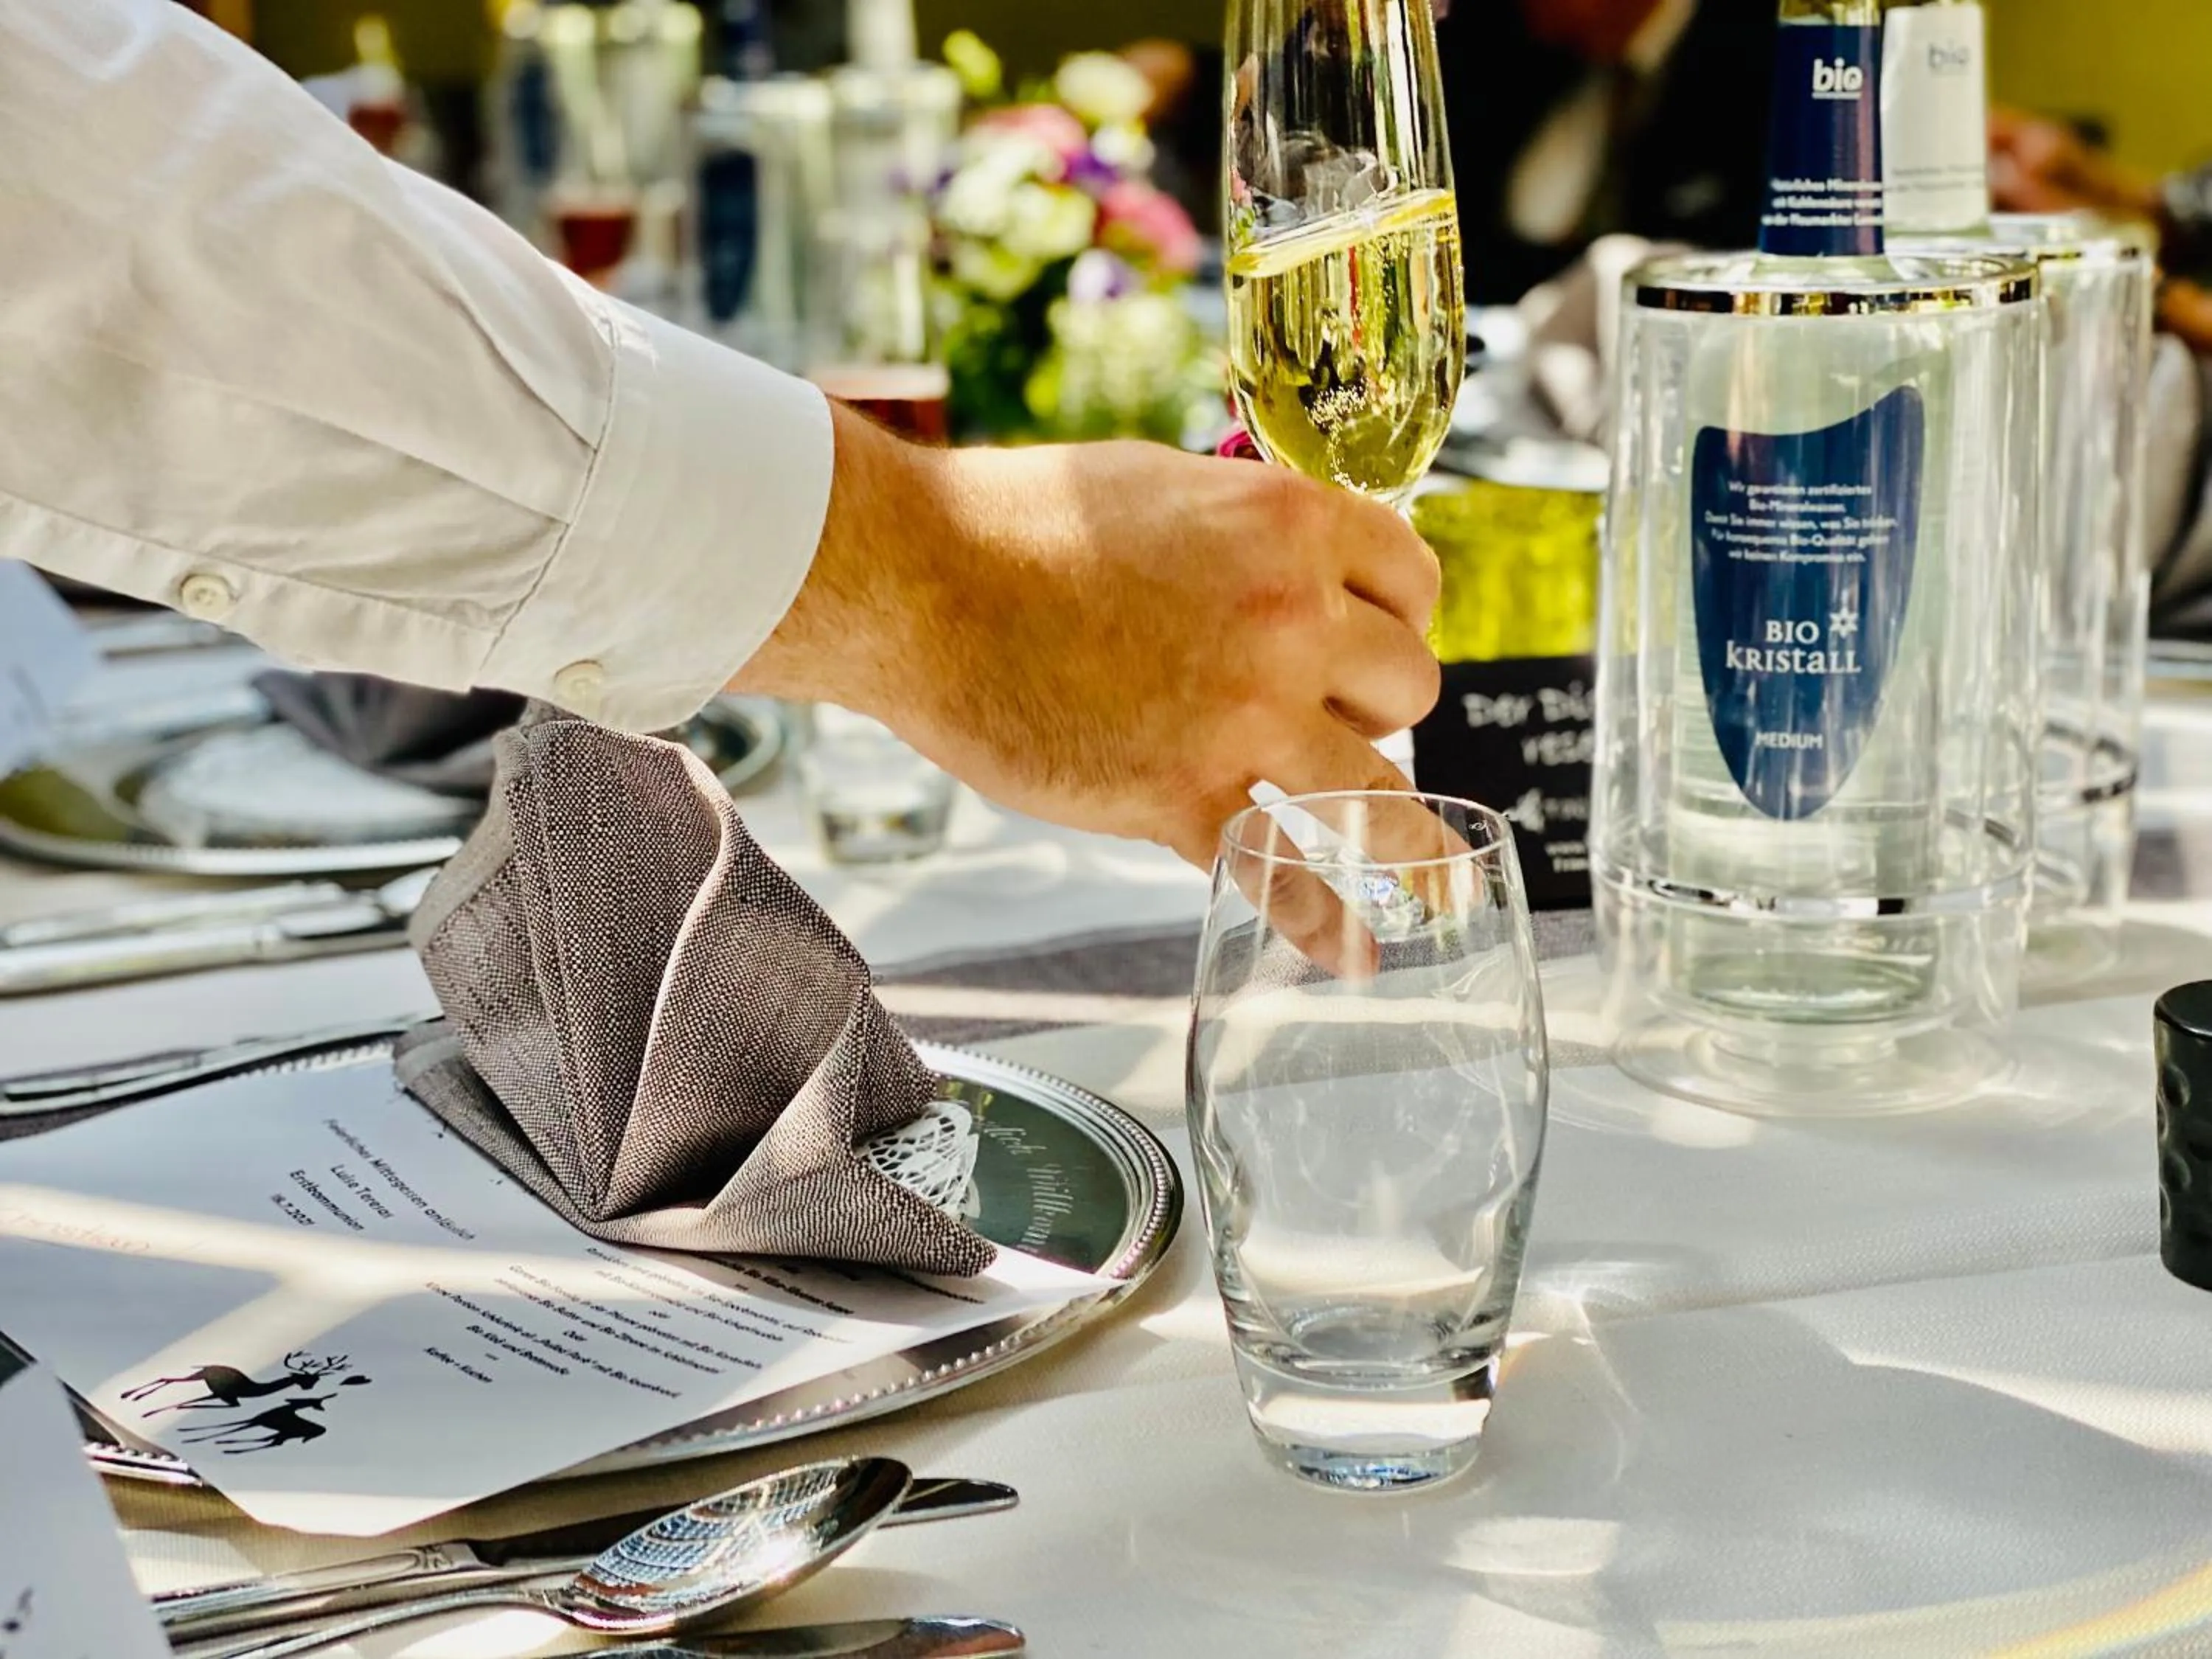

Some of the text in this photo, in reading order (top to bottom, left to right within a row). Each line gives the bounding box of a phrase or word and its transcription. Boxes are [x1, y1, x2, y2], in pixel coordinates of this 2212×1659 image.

[1812, 58, 1863, 91] bio
[1765, 620, 1820, 644] BIO
[1756, 731, 1823, 749] MEDIUM
